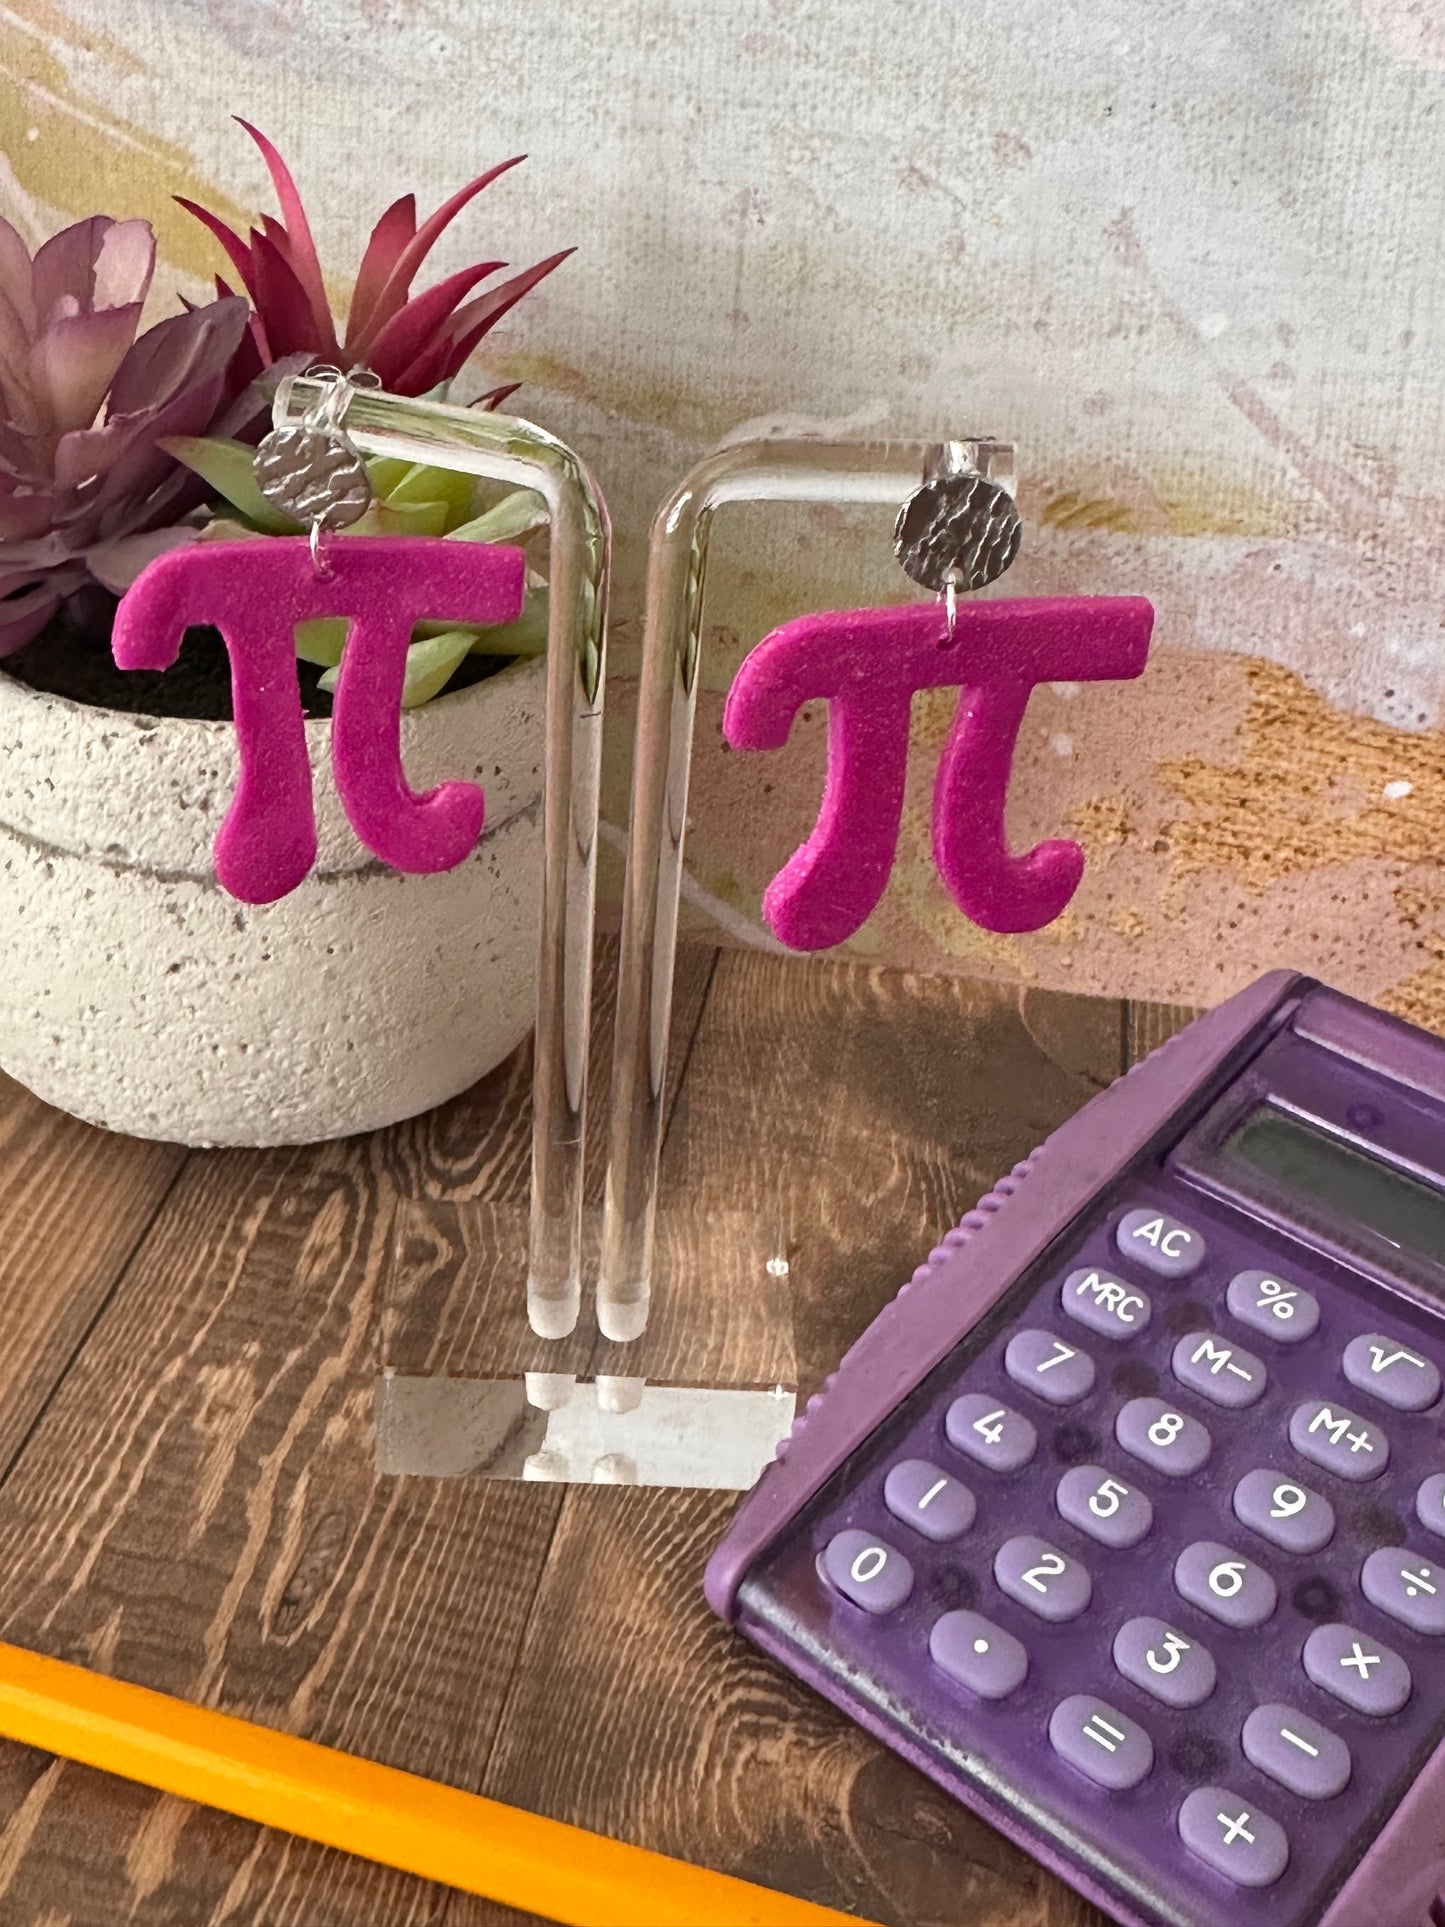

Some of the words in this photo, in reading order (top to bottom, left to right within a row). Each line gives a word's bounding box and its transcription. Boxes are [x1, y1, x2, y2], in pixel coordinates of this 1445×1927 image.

[1132, 1217, 1192, 1258] AC
[1075, 1271, 1145, 1323] MRC
[1255, 1279, 1299, 1320] %
[1036, 1342, 1076, 1374] 7
[972, 1410, 1006, 1446] 4
[1147, 1413, 1184, 1447] 8
[1308, 1407, 1374, 1454] M+
[918, 1479, 947, 1510] 1
[1088, 1479, 1129, 1518] 5
[1270, 1484, 1307, 1519] 9
[850, 1546, 888, 1583] 0
[1021, 1553, 1067, 1593] 2
[1208, 1561, 1247, 1598] 6
[1146, 1631, 1191, 1675] 3
